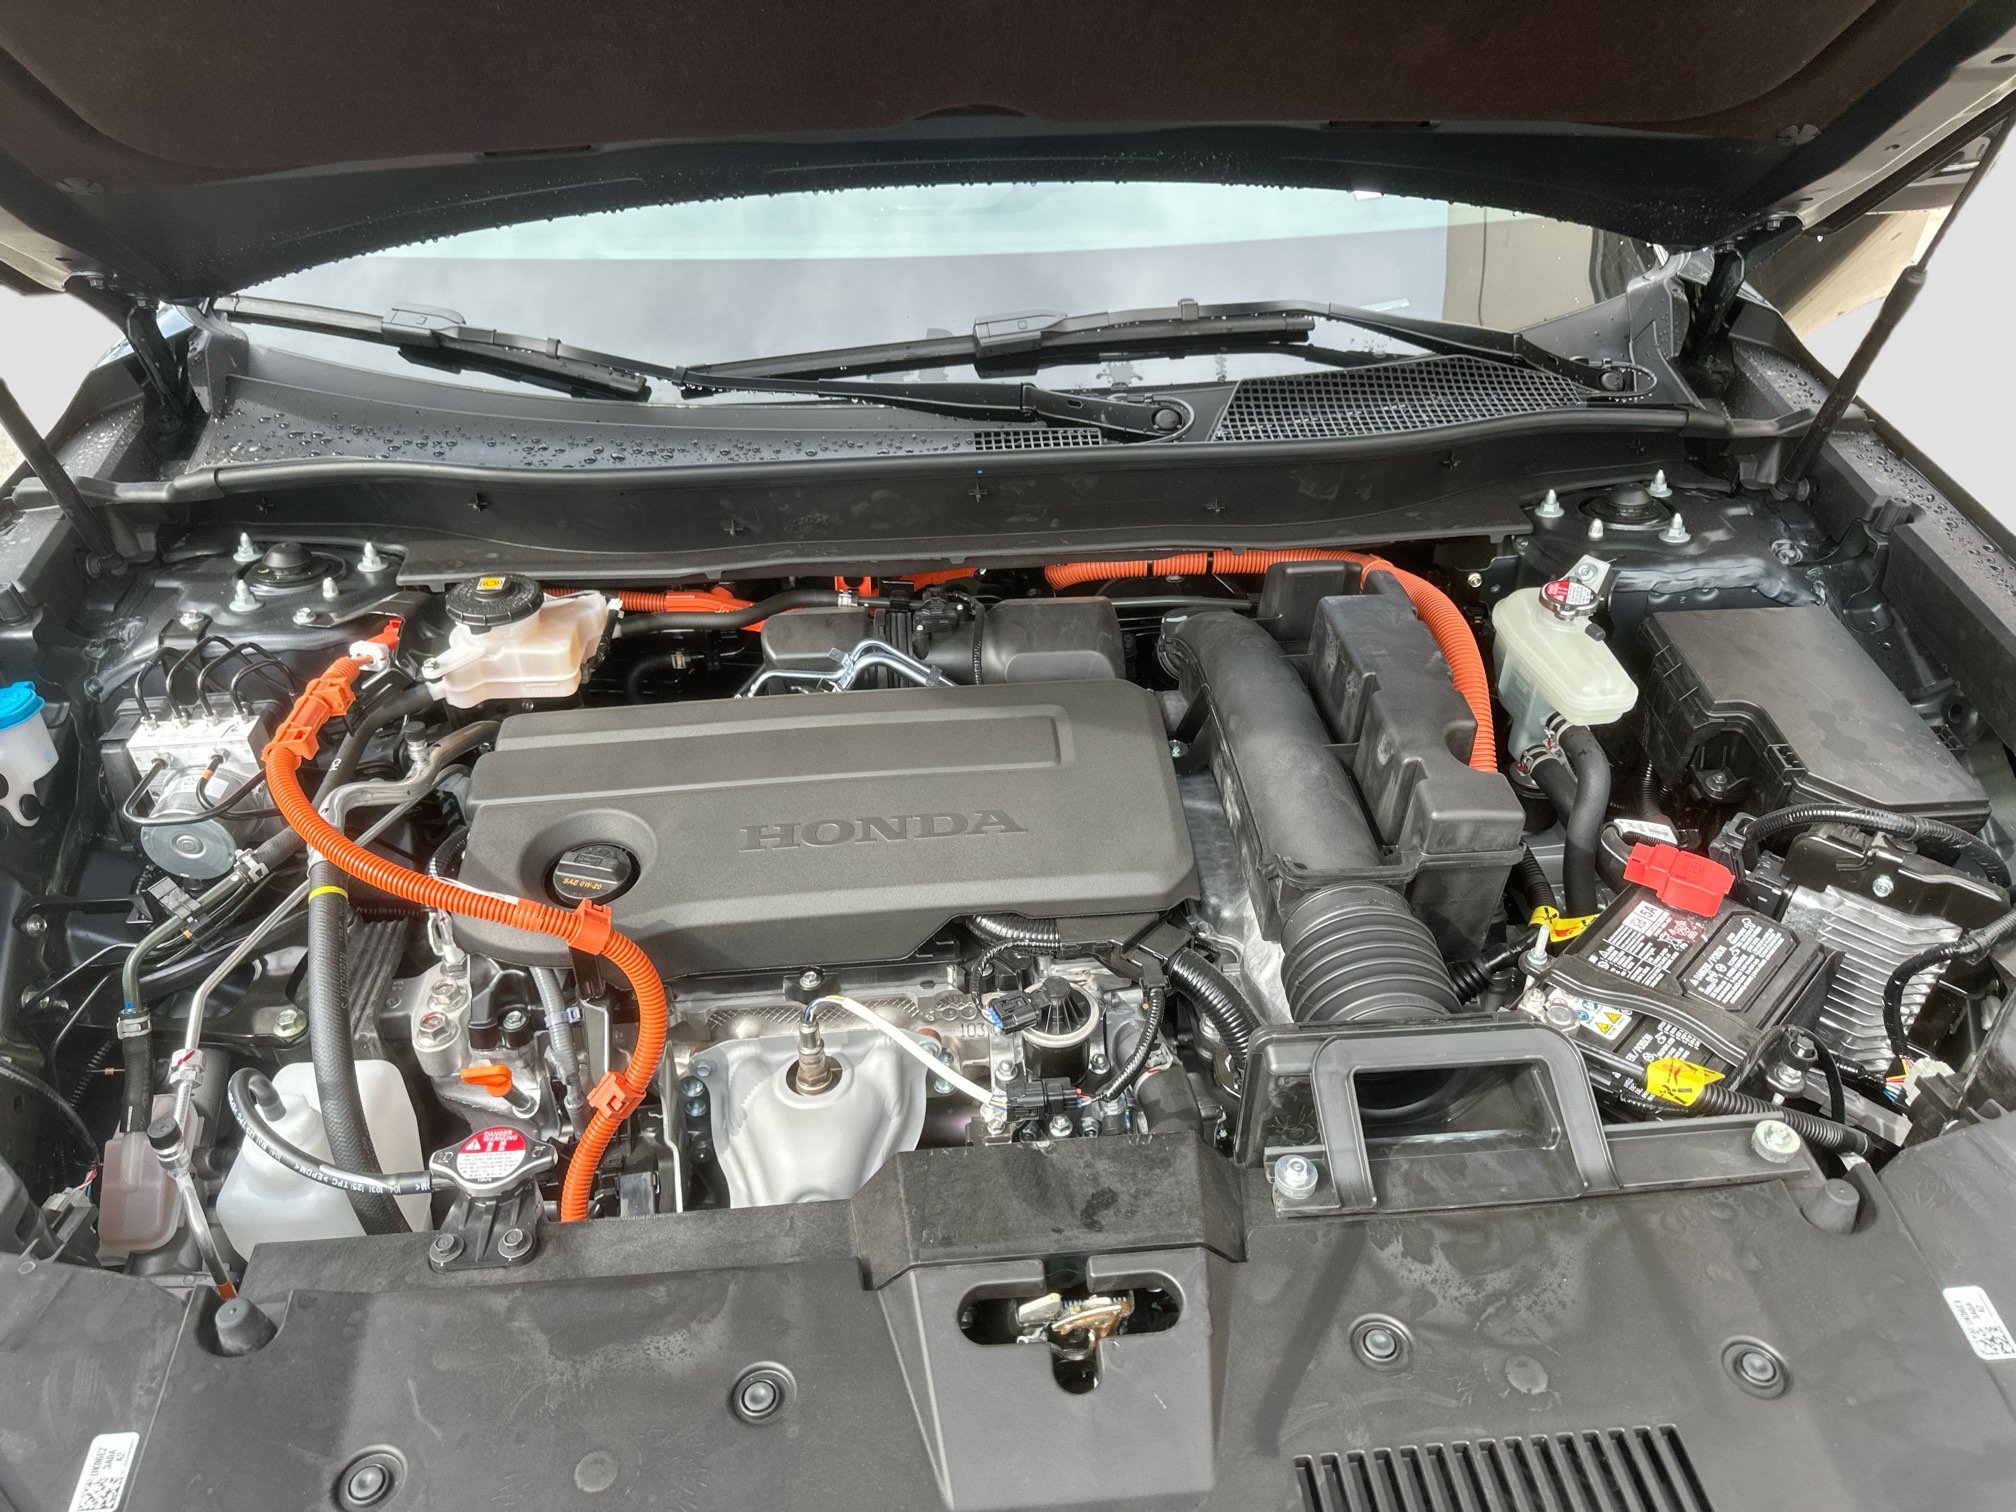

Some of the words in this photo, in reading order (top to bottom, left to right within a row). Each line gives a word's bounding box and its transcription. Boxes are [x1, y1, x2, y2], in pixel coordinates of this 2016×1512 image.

[738, 809, 1027, 853] HONDA
[562, 877, 579, 887] SAE
[580, 881, 603, 890] 0W-20
[484, 1130, 513, 1139] DANGER
[331, 1177, 349, 1189] TPC
